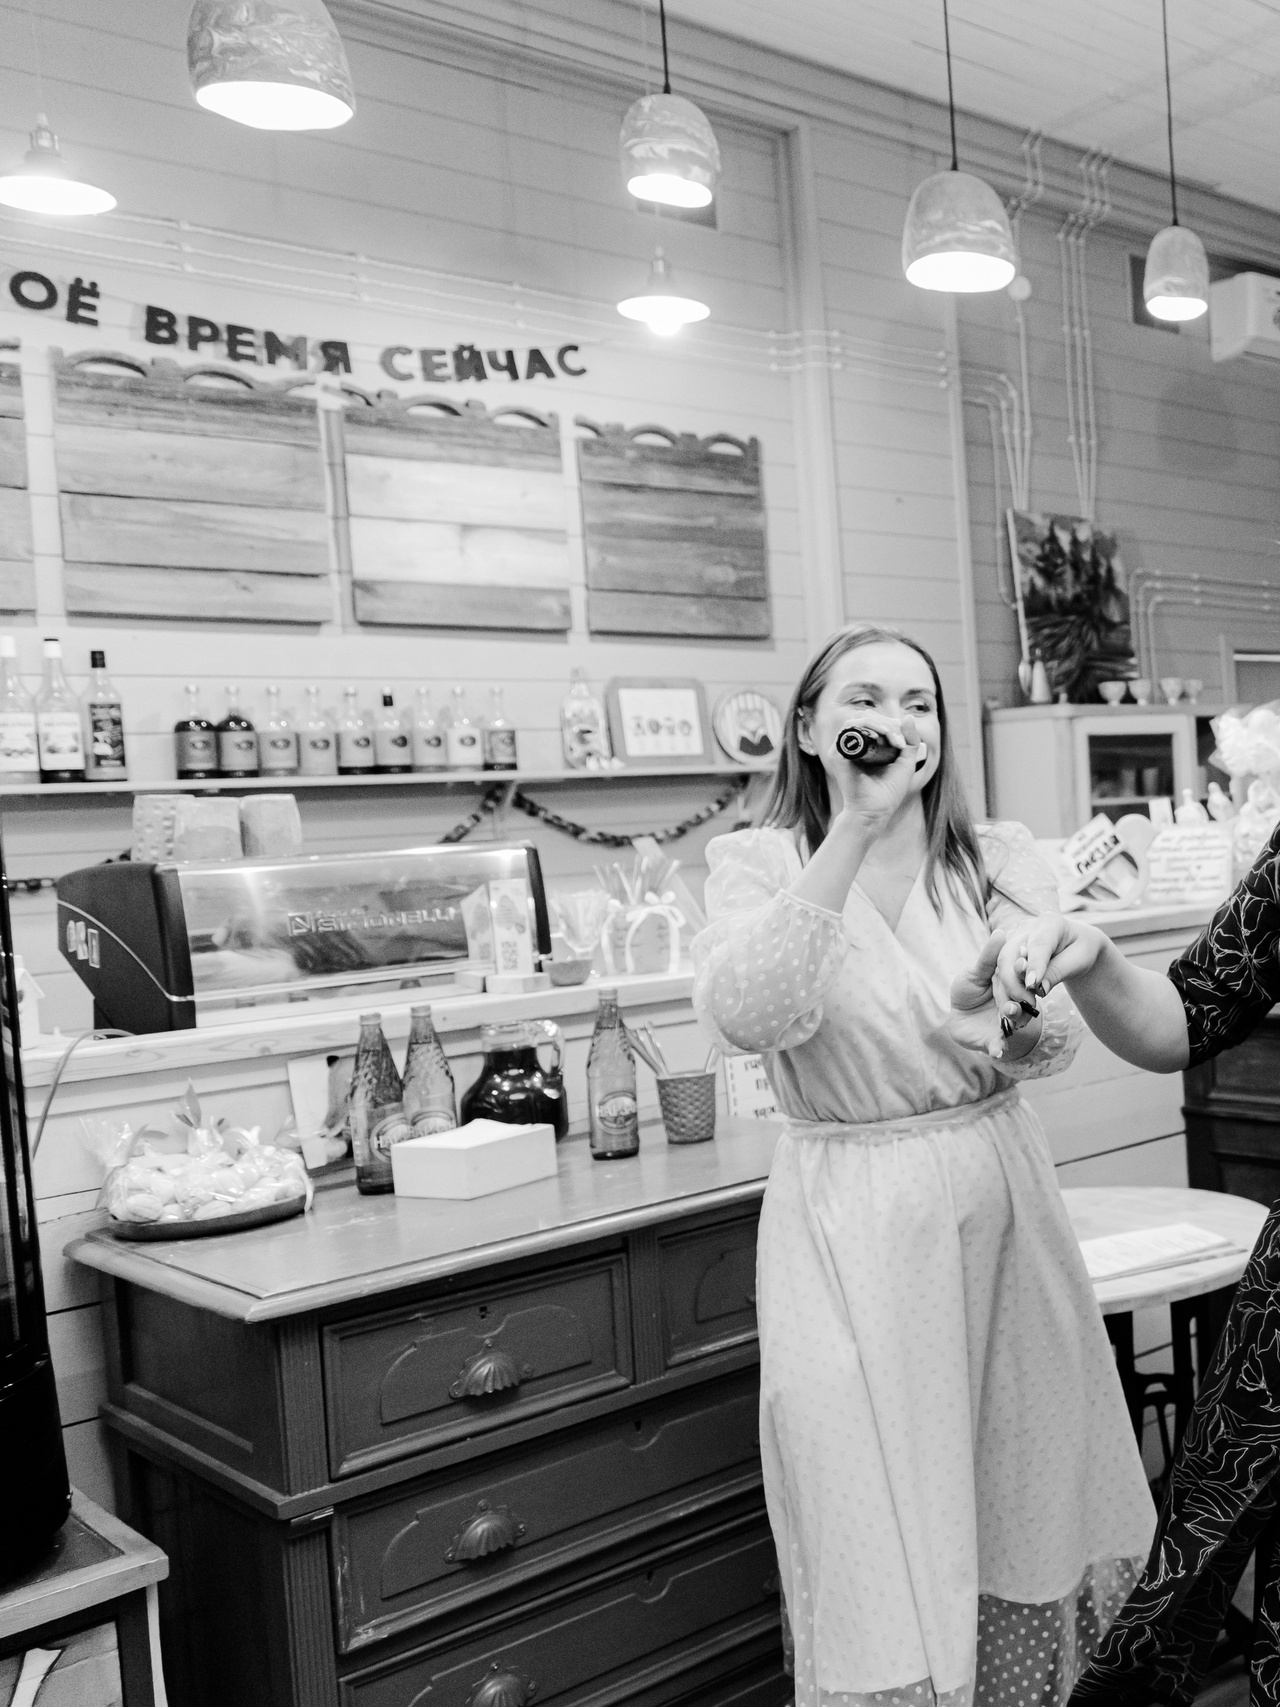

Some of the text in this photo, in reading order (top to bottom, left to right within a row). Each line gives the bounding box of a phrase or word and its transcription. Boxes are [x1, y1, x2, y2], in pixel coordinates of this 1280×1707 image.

[9, 271, 587, 383] ОЁ ВРЕМЯ СЕЙЧАС
